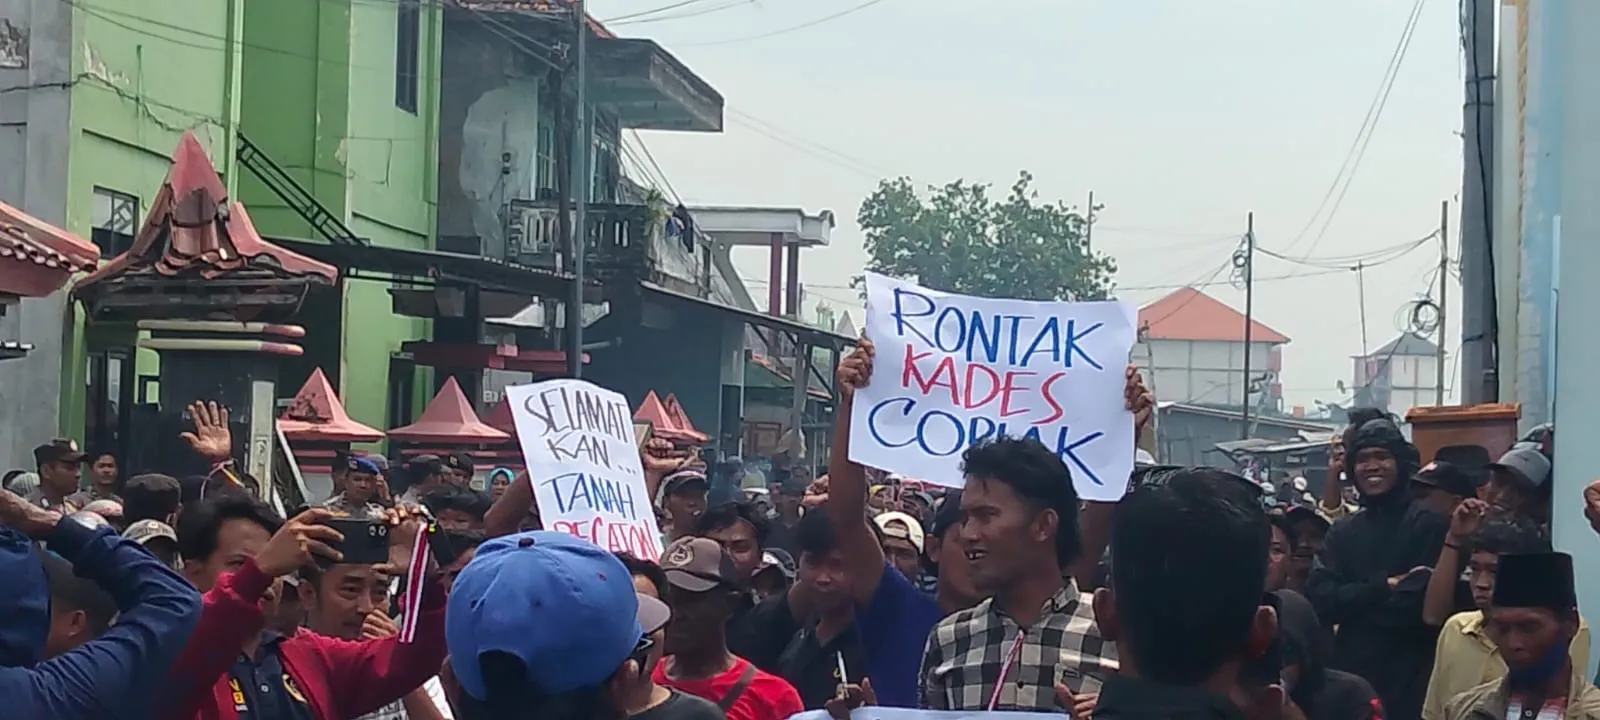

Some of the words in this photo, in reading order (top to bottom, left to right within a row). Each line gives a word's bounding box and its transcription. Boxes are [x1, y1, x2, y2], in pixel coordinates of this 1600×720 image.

[891, 288, 1104, 370] RONTAK
[524, 387, 628, 443] SELAMAT
[902, 344, 1067, 425] KADES
[541, 472, 637, 521] TANAH
